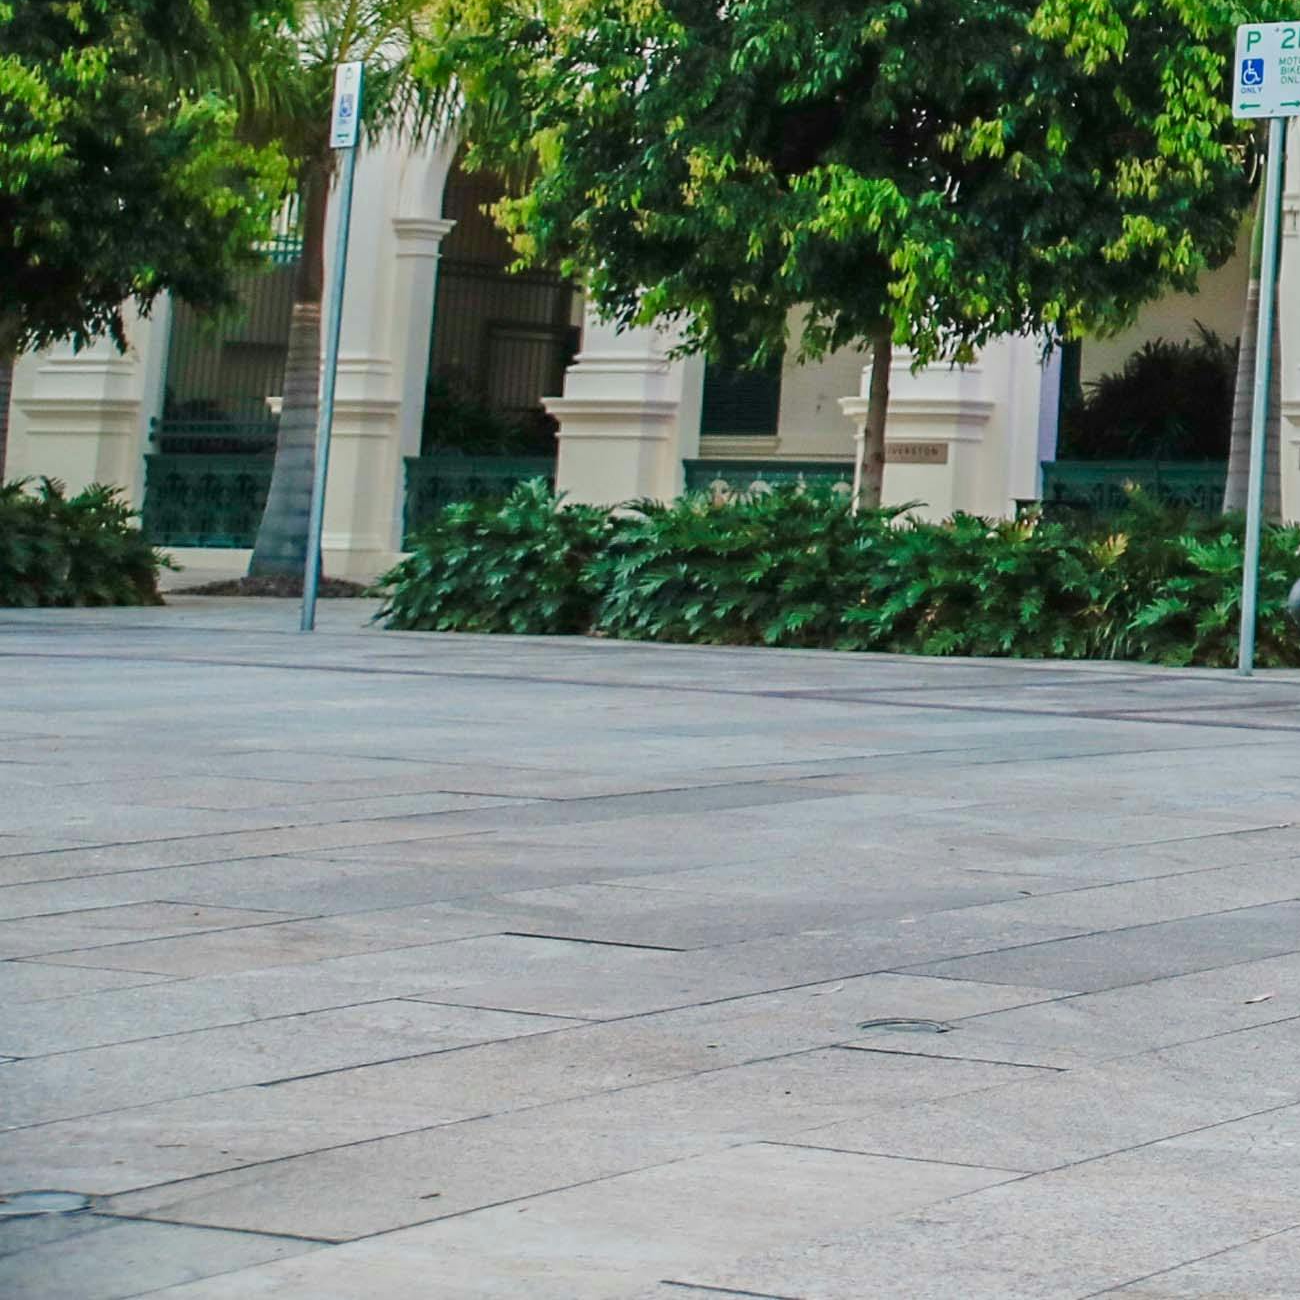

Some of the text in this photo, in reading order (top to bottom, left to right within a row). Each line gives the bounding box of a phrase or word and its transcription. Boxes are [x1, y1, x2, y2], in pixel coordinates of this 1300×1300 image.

[1246, 30, 1262, 52] P
[1240, 86, 1263, 94] ONLY
[886, 445, 939, 457] IVERSTON
